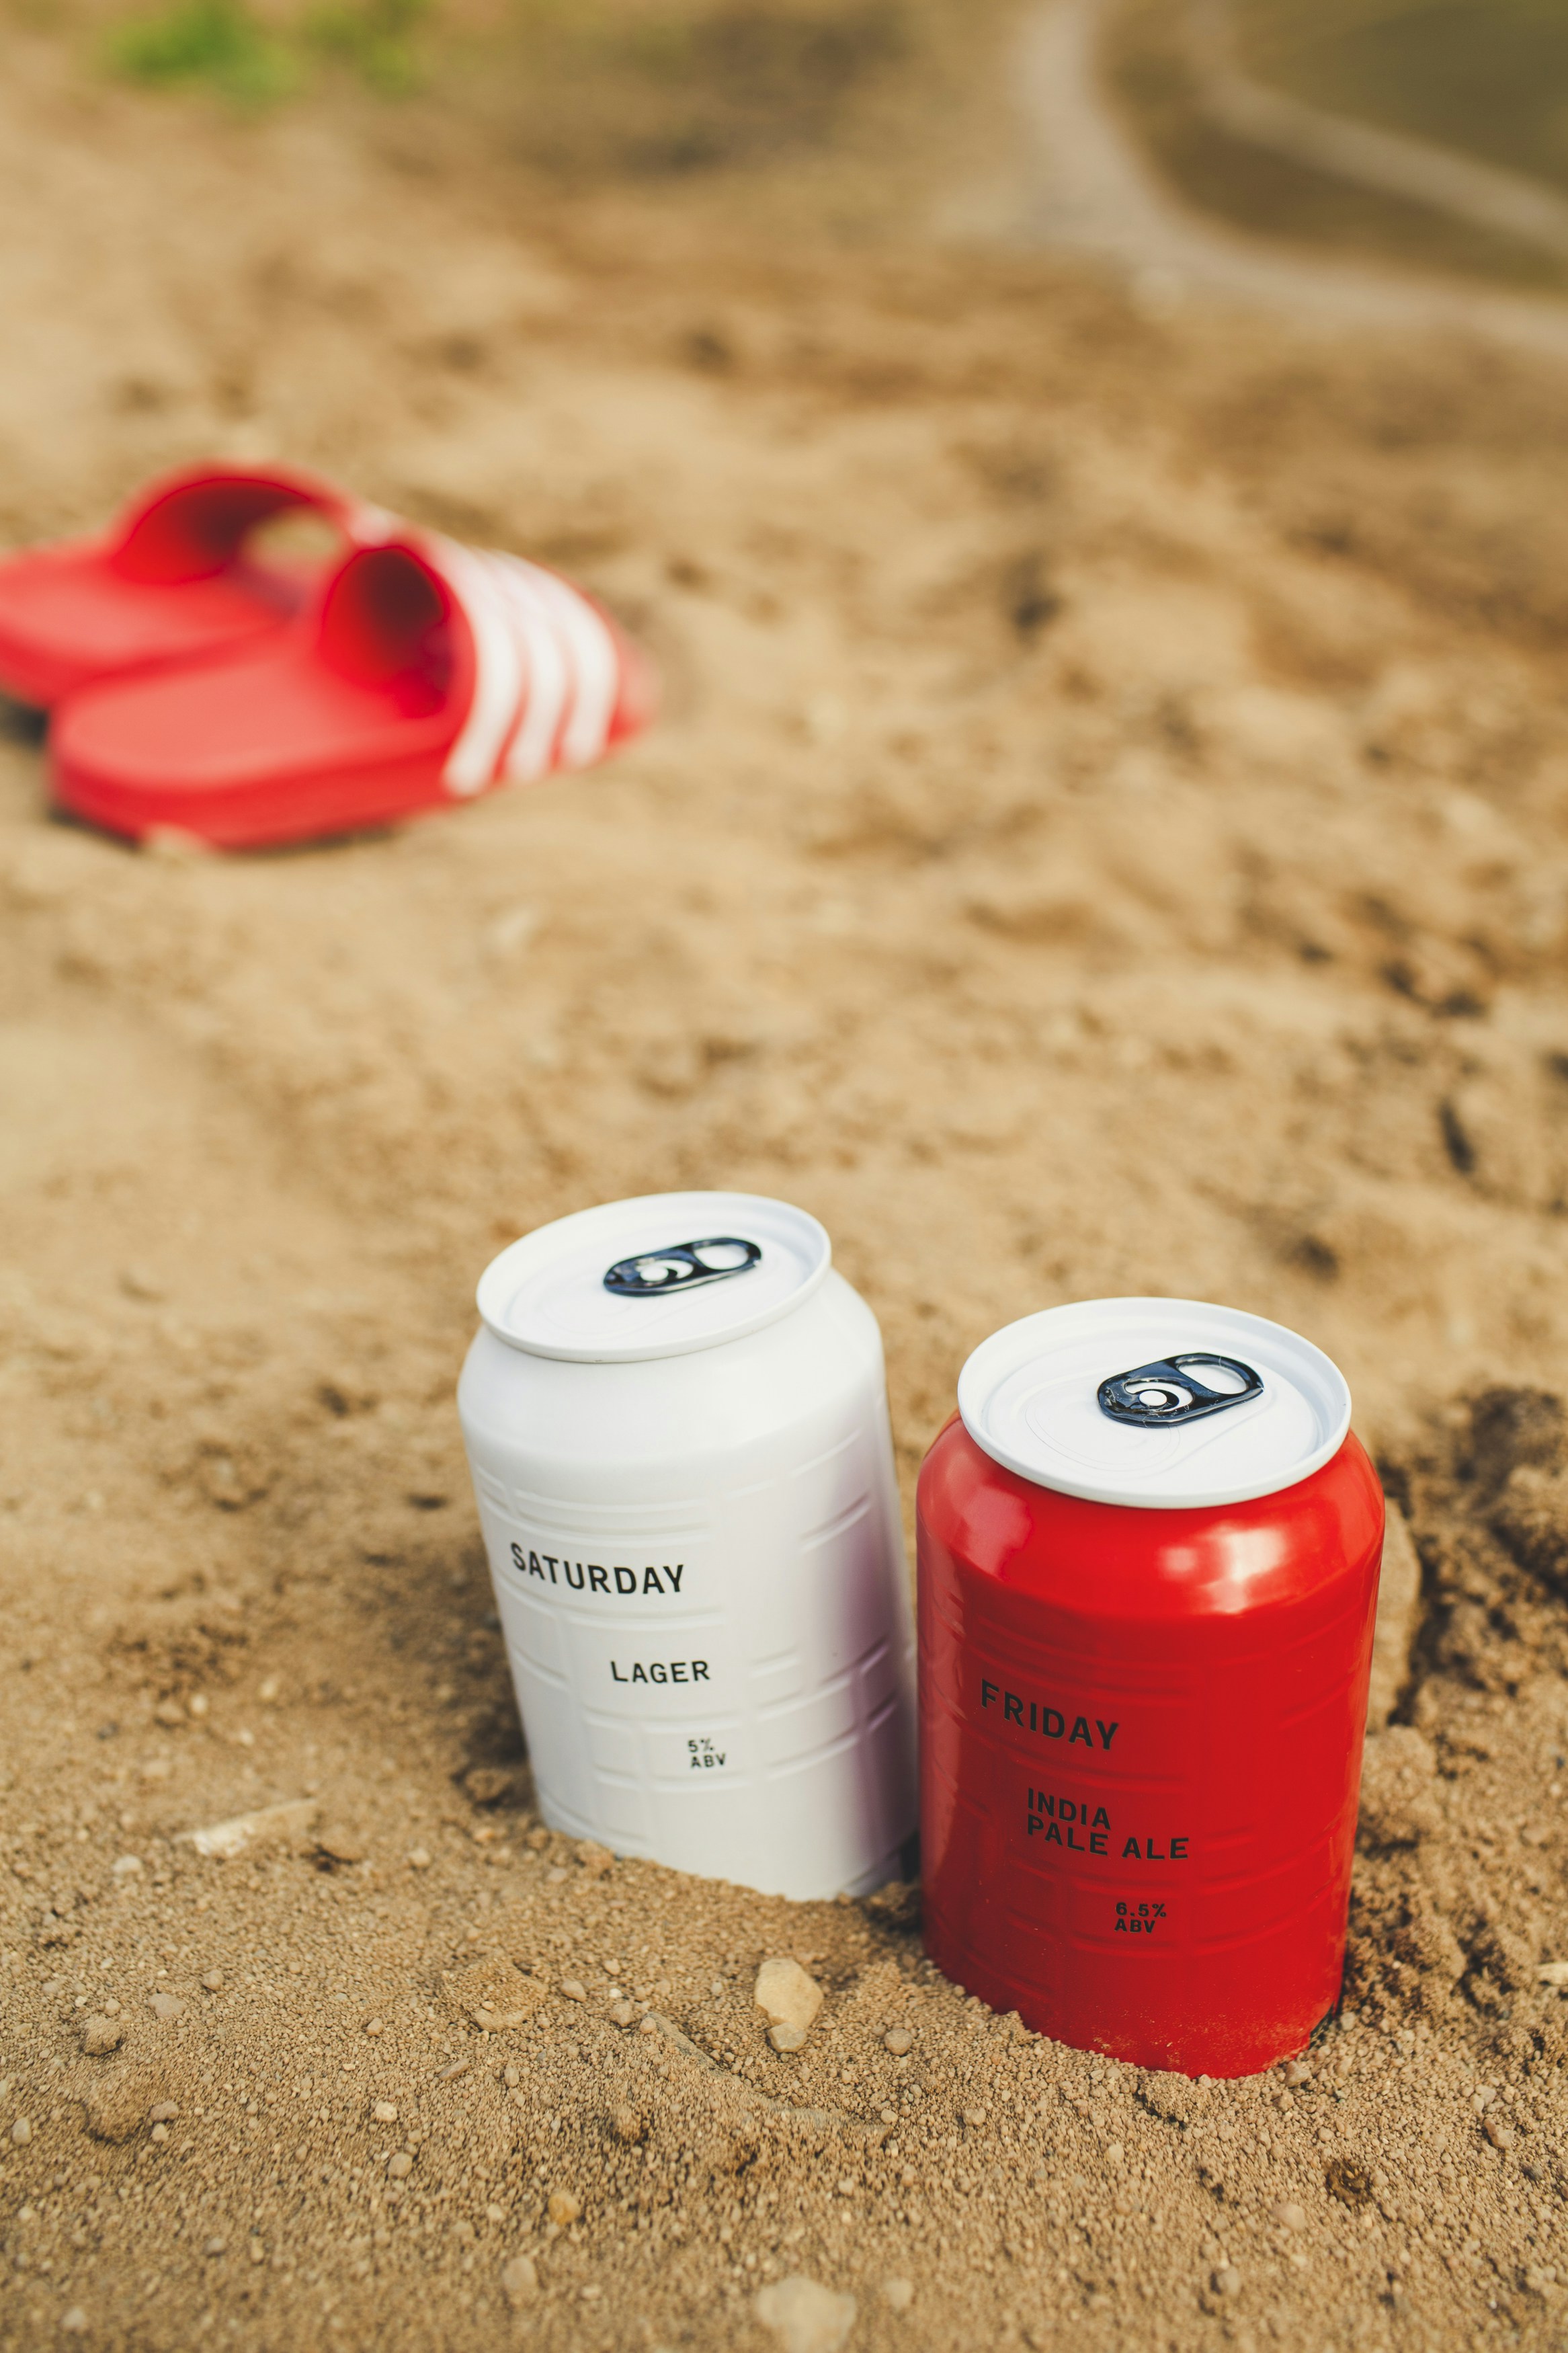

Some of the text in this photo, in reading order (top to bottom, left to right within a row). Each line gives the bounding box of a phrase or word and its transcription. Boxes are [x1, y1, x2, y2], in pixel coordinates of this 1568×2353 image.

[510, 1542, 684, 1594] SATURDAY
[610, 1661, 710, 1683] LAGER
[981, 1678, 1119, 1750] FRIDAY
[688, 1738, 714, 1753] 5%
[690, 1753, 727, 1769] ABV
[1028, 1788, 1112, 1831] INDIA
[1027, 1813, 1189, 1860] PALE ALE
[1115, 1902, 1167, 1918] 6.5%
[1114, 1919, 1155, 1933] ABV
